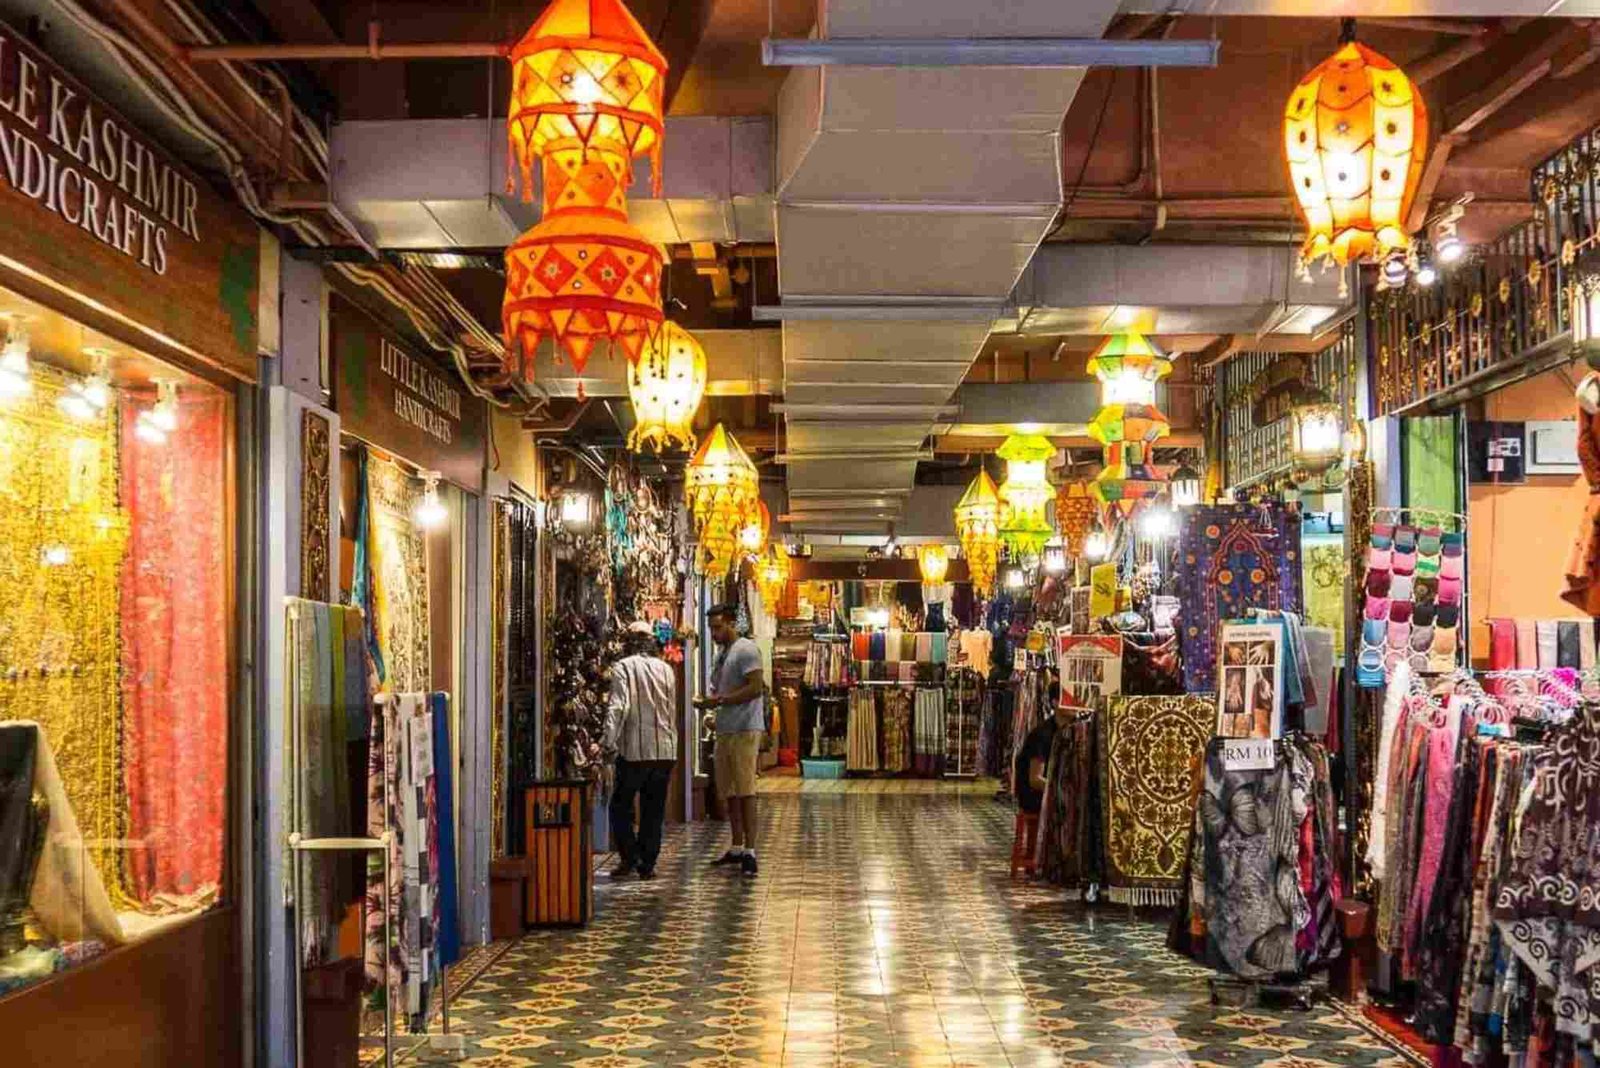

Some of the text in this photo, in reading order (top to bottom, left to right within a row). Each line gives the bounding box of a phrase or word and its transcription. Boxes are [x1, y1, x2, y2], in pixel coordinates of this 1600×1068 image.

[48, 76, 201, 241] KASHMIR
[380, 338, 418, 393] LITTLE
[1226, 747, 1250, 760] RM
